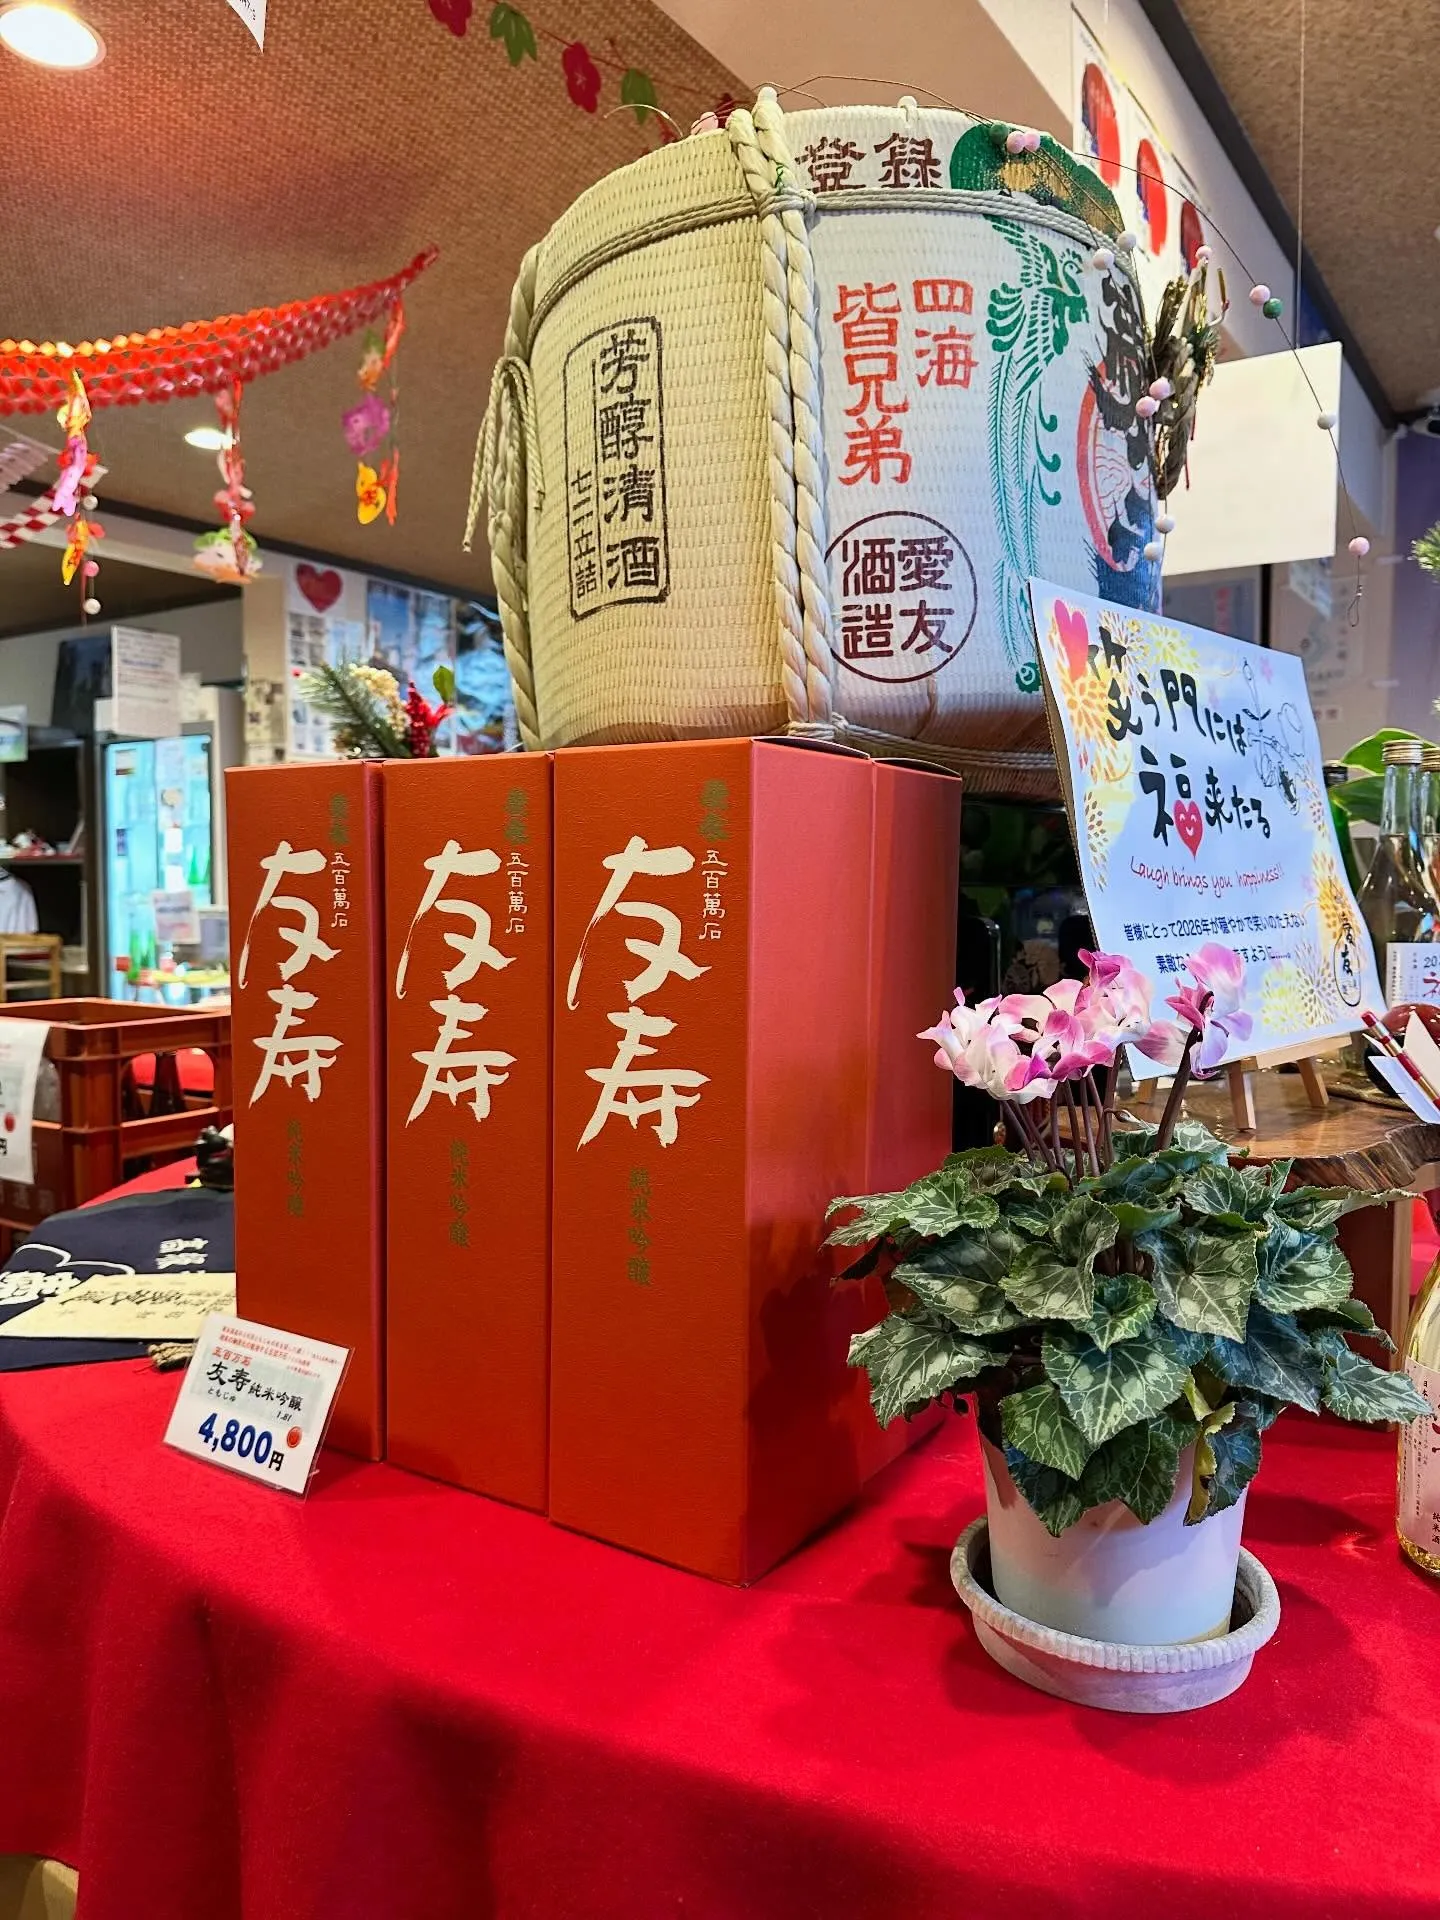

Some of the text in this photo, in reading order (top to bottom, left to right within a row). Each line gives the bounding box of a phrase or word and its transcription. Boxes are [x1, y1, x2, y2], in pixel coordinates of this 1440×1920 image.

[833, 281, 911, 486] 皆兄弟
[912, 278, 980, 390] 四海
[600, 329, 660, 590] 芳醇清酒
[841, 537, 896, 660] 酒造
[898, 535, 956, 655] 愛友
[1087, 626, 1247, 757] 笑う門には
[1138, 744, 1271, 852] 福来たる
[331, 852, 351, 928] 五百萬石
[505, 852, 530, 934] 五百萬石
[699, 849, 729, 940] 五百萬石
[1130, 855, 1170, 889] Laugh
[1171, 865, 1209, 895] brings
[1211, 873, 1233, 898] you
[238, 840, 344, 1108] 友寿
[396, 839, 518, 1128] 友寿
[566, 835, 713, 1152] 友寿
[198, 1412, 285, 1472] 4,800円
